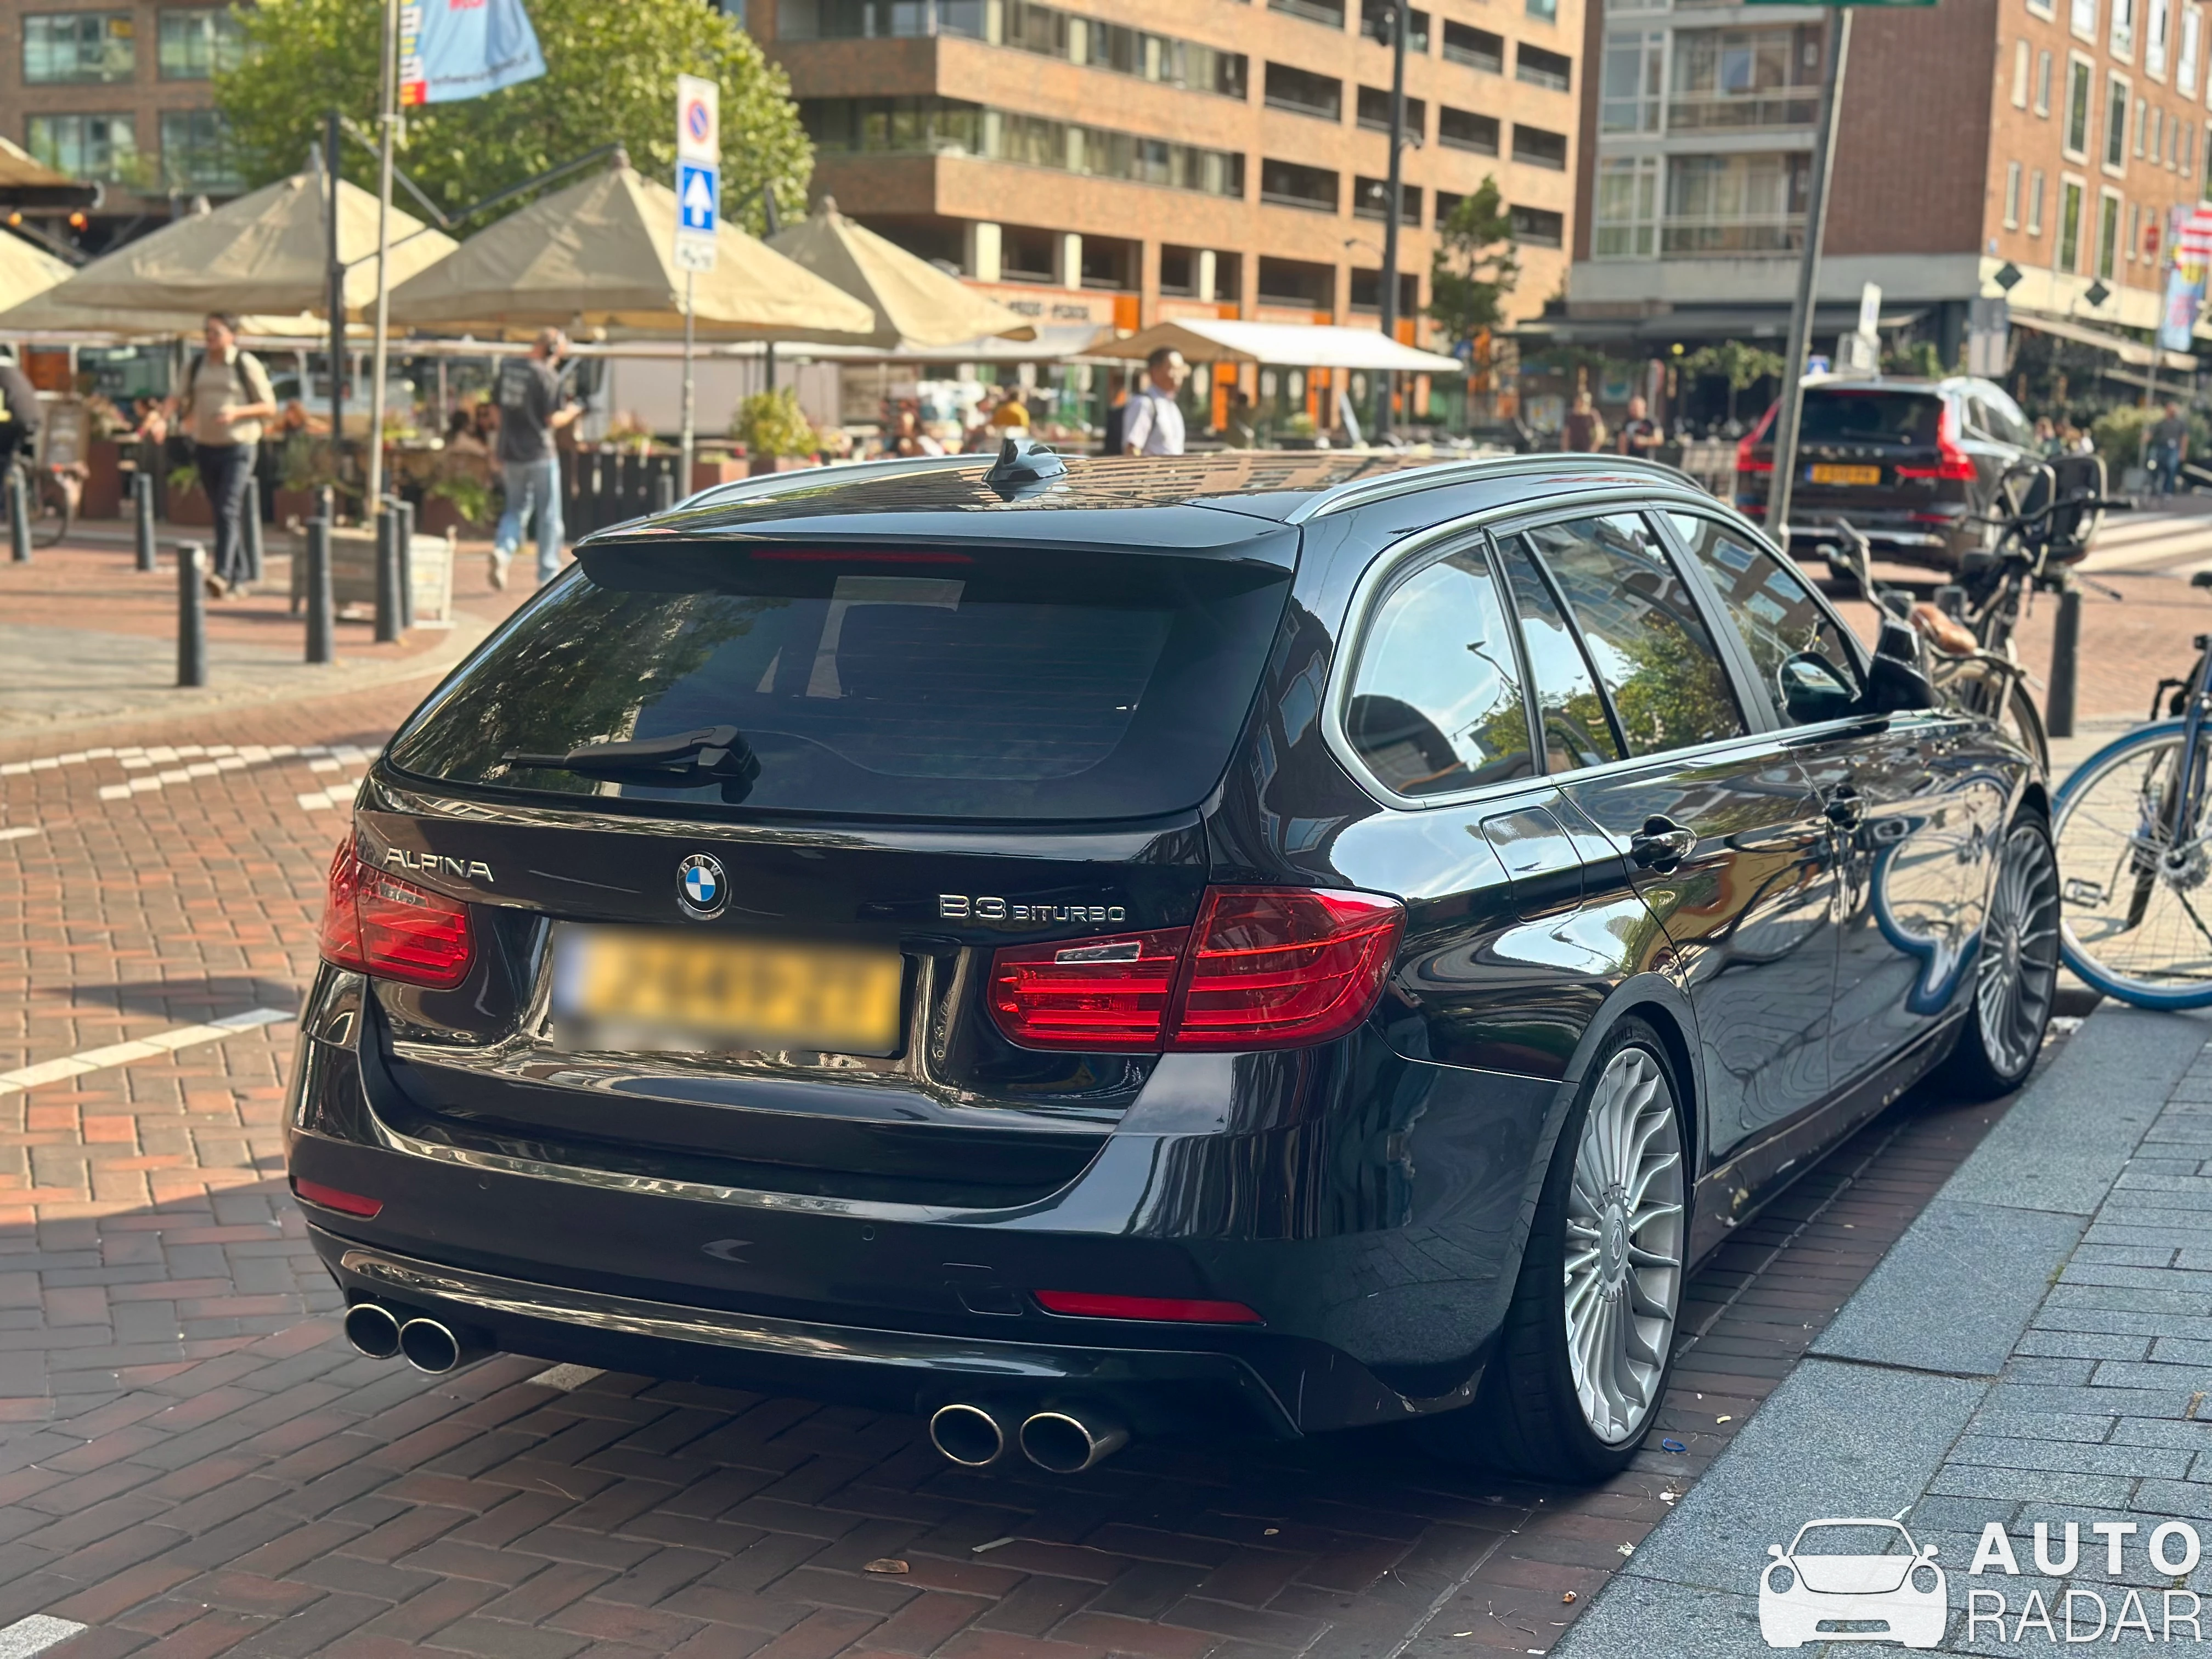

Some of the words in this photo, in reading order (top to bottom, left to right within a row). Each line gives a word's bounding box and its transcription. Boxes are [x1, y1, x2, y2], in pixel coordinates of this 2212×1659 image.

[381, 847, 494, 883] ALPINA
[680, 856, 721, 876] BMW
[939, 894, 1006, 920] B3
[1013, 905, 1125, 923] BITURBO
